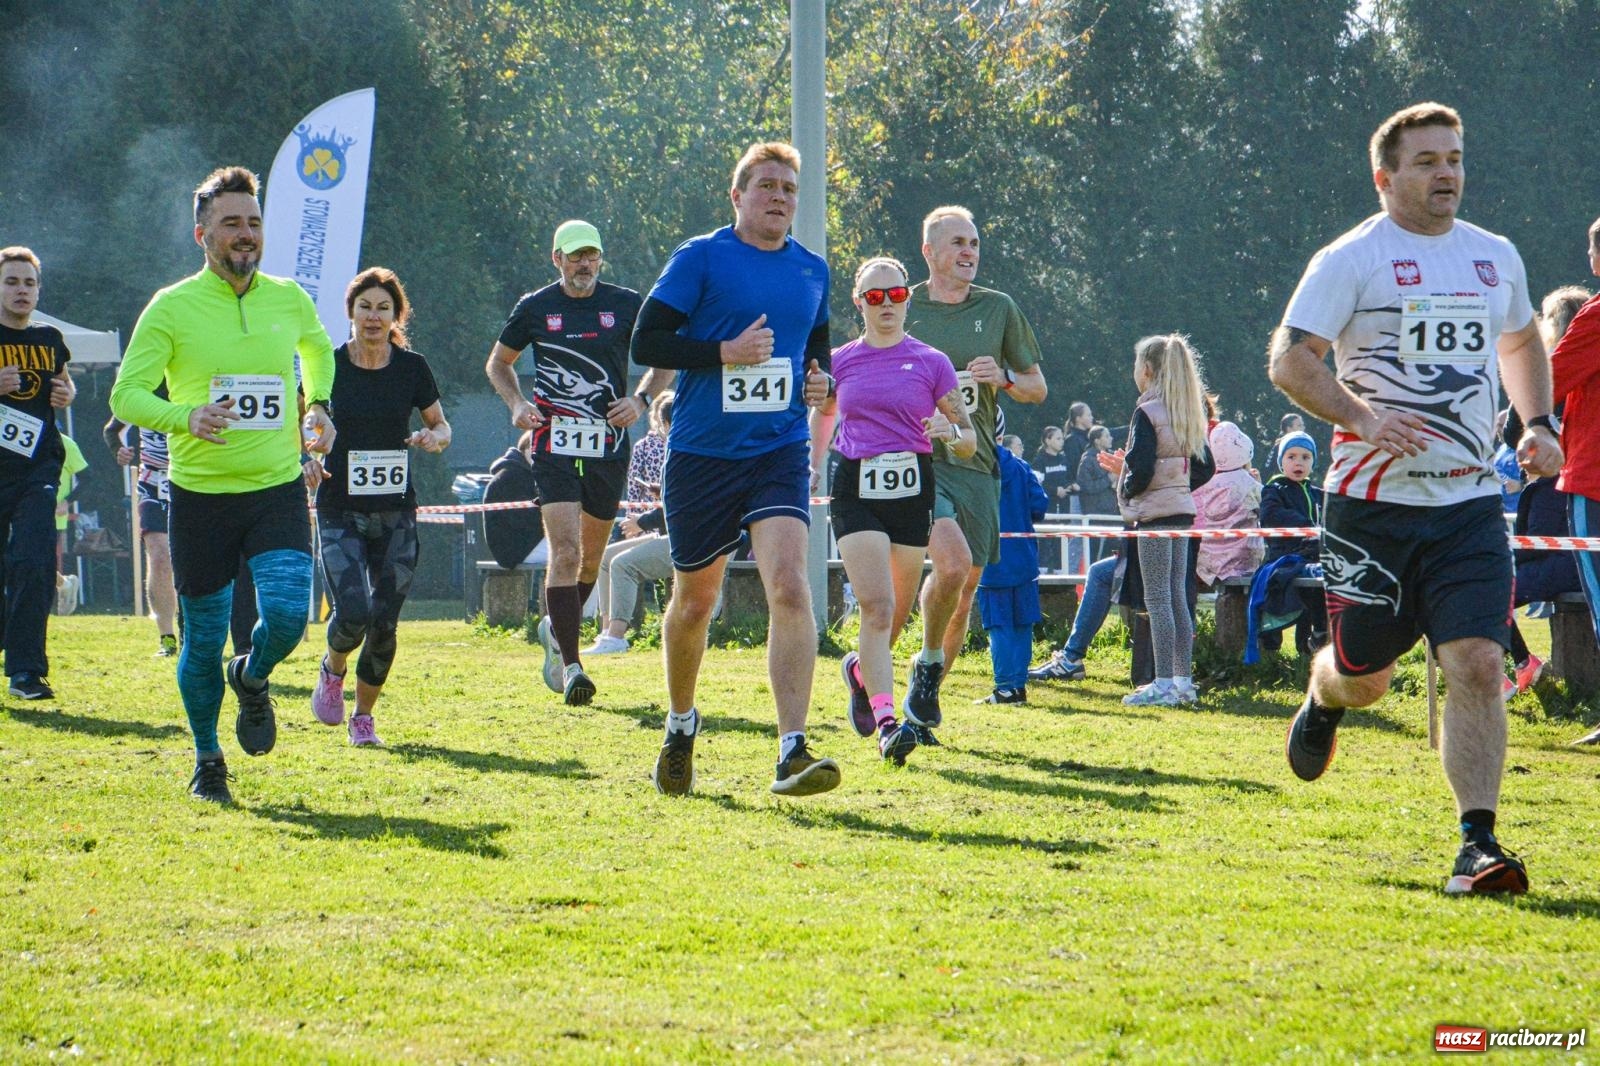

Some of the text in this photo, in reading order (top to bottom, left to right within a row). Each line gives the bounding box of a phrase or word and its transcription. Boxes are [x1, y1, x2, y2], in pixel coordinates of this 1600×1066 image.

[295, 197, 330, 280] STOWARZYSZENIE
[1408, 320, 1485, 352] 183
[728, 376, 786, 402] 341
[554, 429, 599, 450] 311
[353, 466, 404, 487] 356
[864, 467, 917, 491] 190
